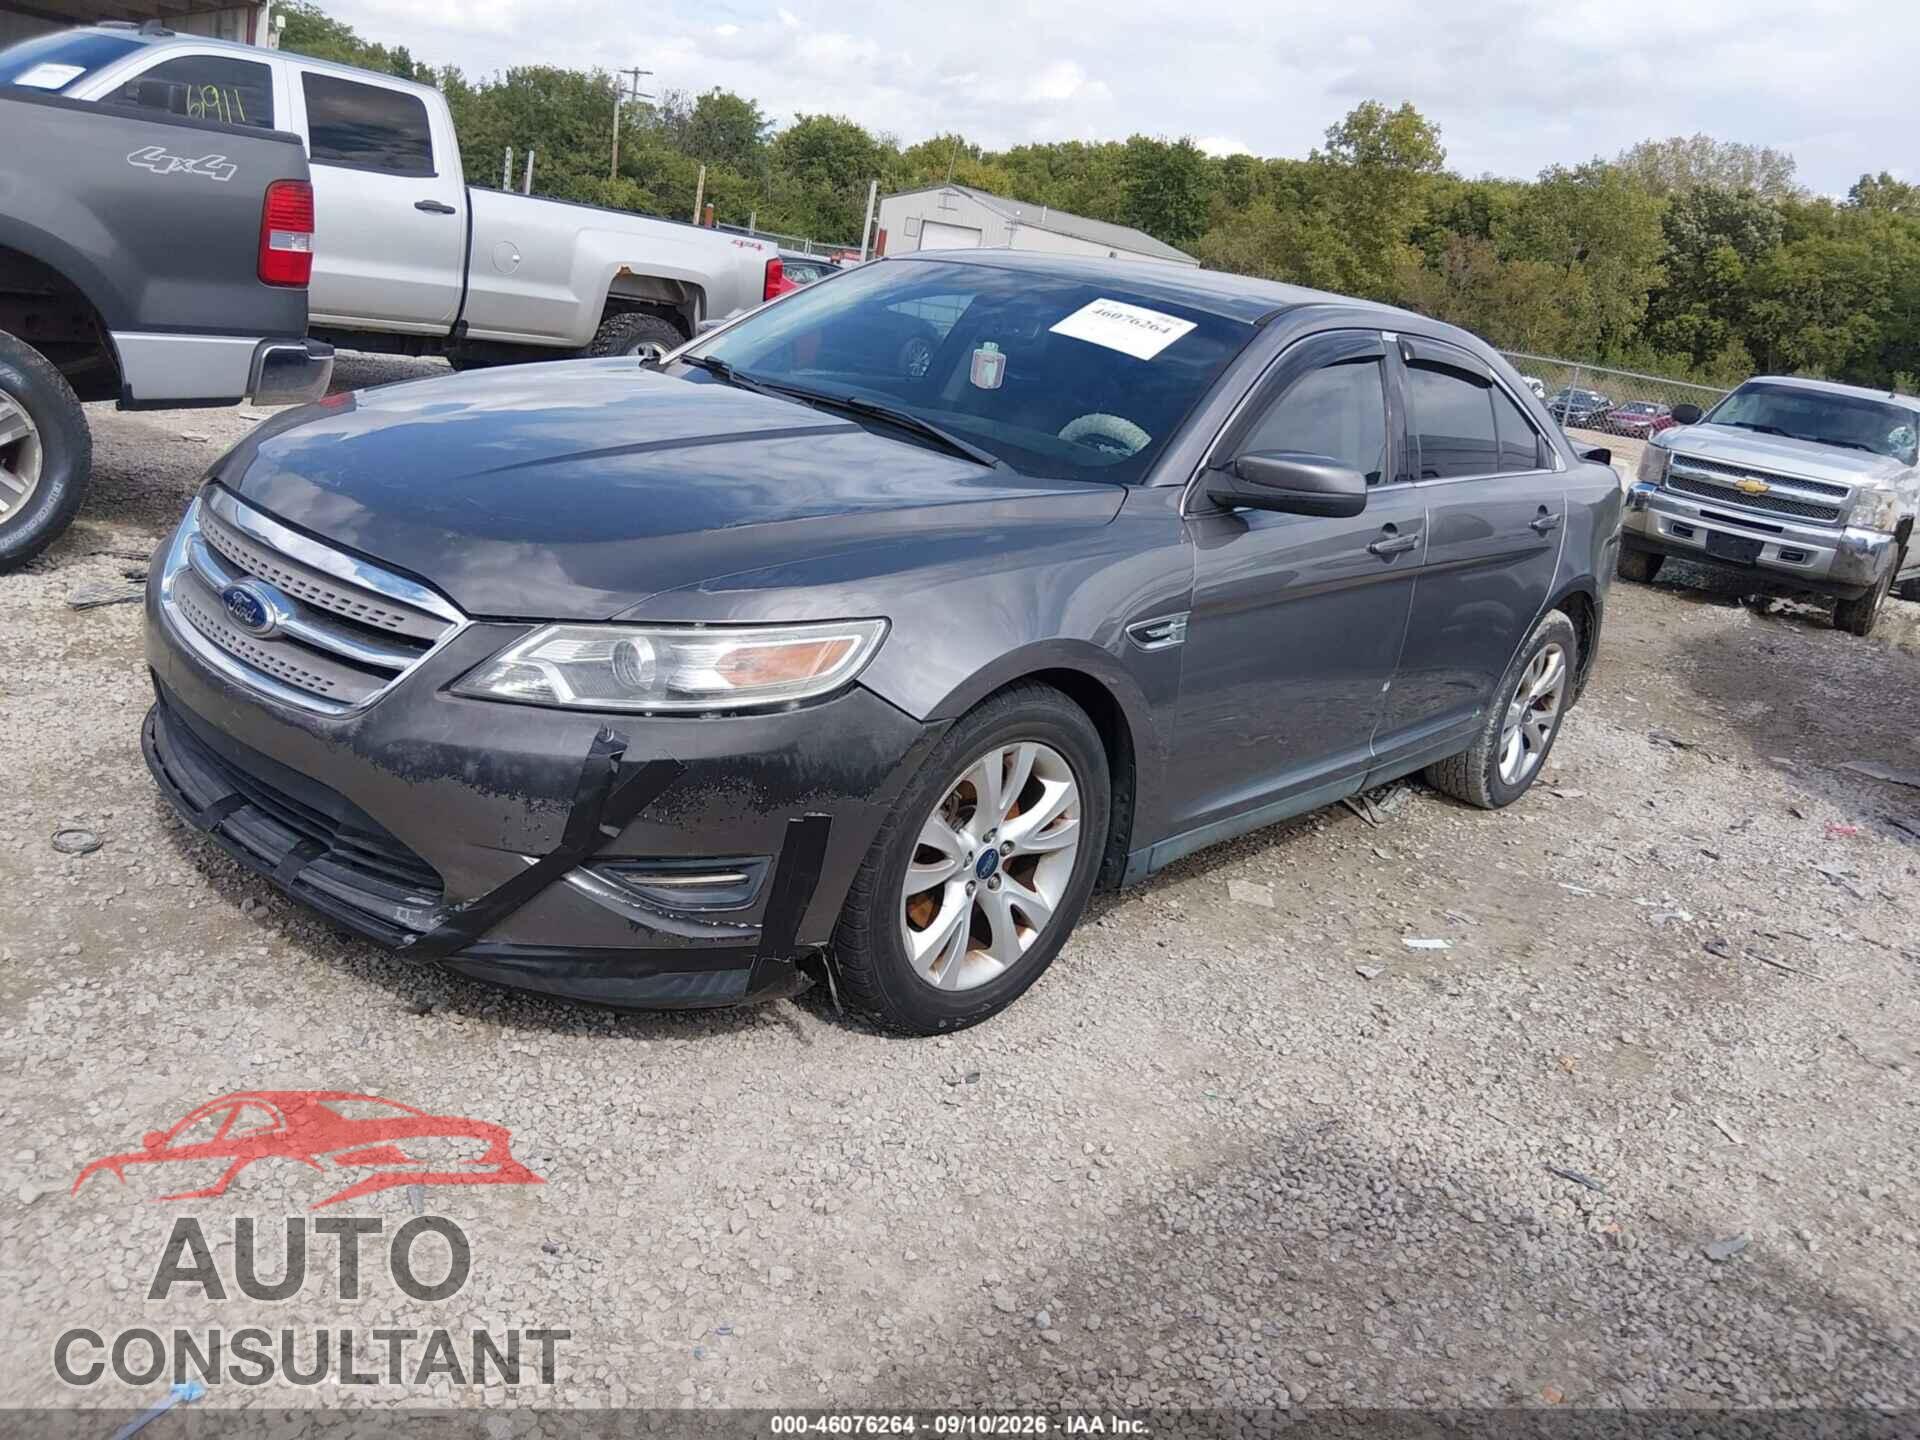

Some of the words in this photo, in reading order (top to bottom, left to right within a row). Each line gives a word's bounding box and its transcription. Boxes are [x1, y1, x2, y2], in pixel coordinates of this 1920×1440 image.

[186, 84, 246, 124] 6911
[127, 146, 238, 182] 4x4
[228, 591, 257, 623] Ford
